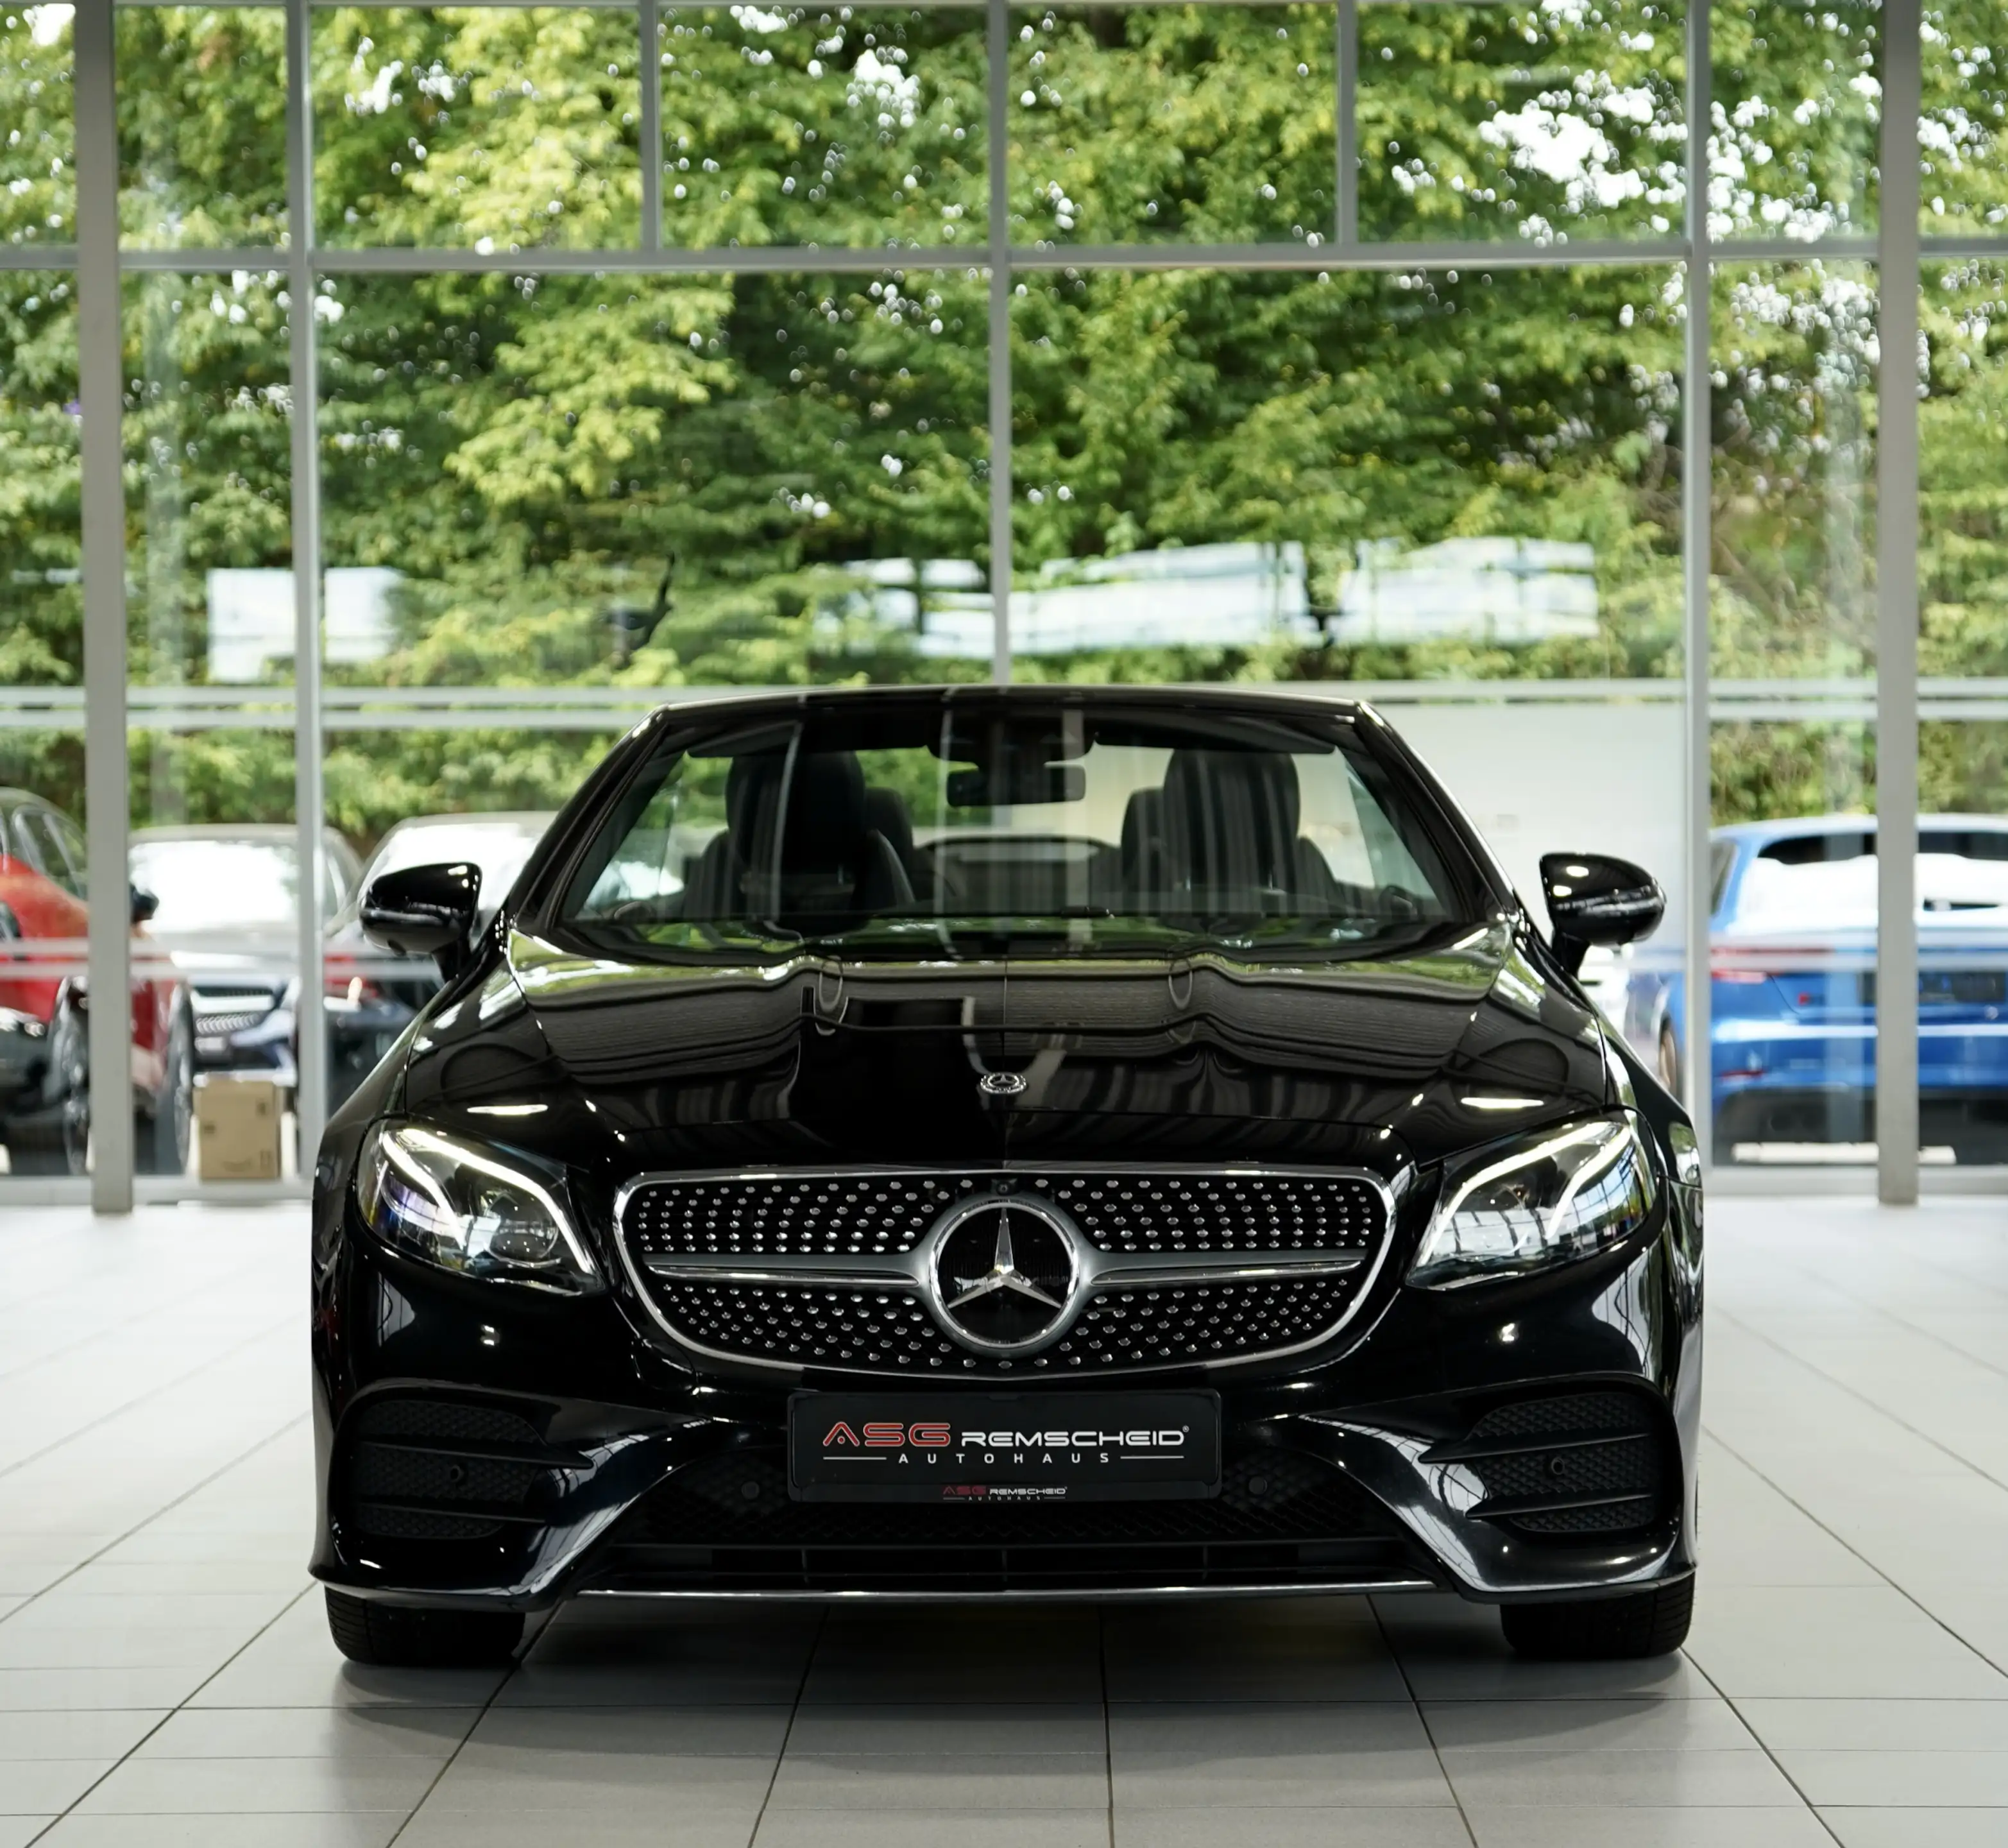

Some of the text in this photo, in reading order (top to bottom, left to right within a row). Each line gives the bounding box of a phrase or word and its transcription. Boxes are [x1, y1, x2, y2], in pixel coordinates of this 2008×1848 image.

[822, 1421, 951, 1447] ASG
[898, 1453, 1109, 1464] AUTOHAUS
[943, 1486, 986, 1495] ASG
